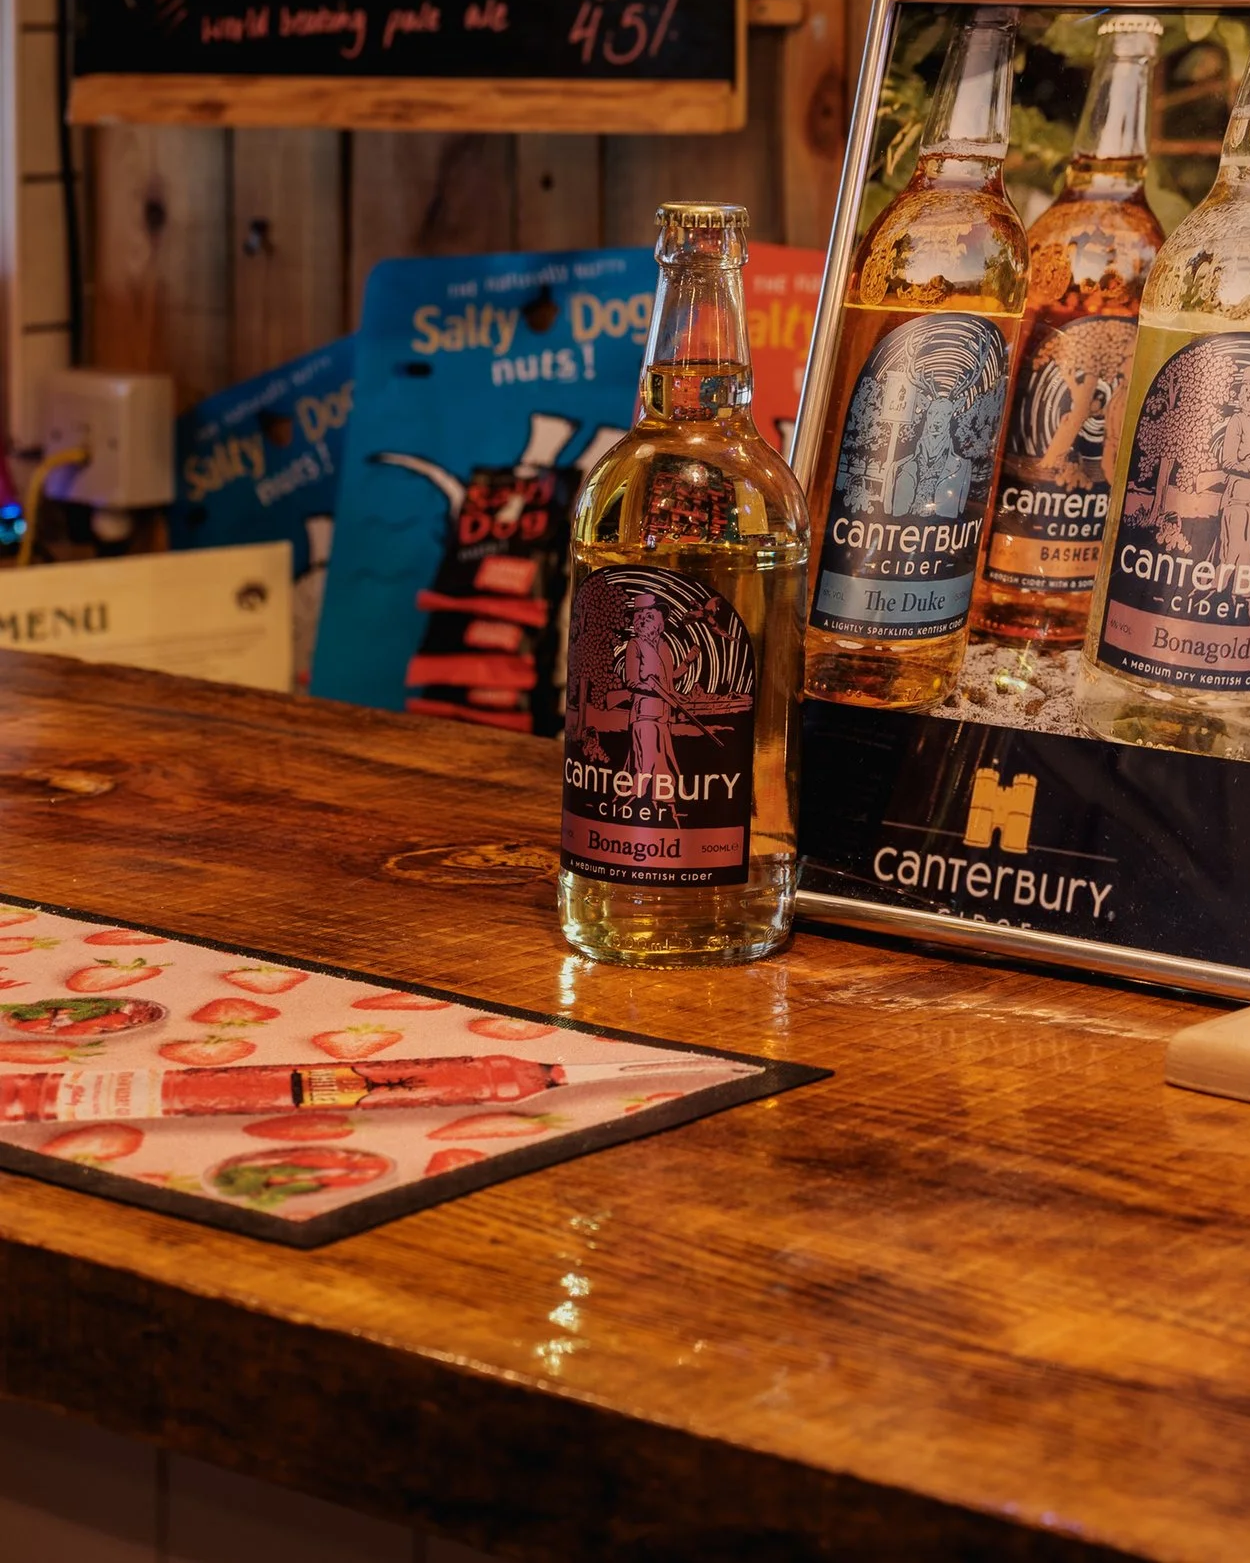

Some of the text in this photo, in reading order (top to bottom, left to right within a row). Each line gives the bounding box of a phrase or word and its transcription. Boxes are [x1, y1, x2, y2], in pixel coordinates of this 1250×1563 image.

[412, 304, 519, 356] Salty
[750, 300, 815, 364] alty
[185, 434, 265, 502] Salty
[864, 590, 897, 612] The
[900, 591, 946, 612] Duke
[831, 620, 864, 633] LIGHTLY
[1121, 658, 1128, 666] A
[588, 829, 681, 862] Bonagold
